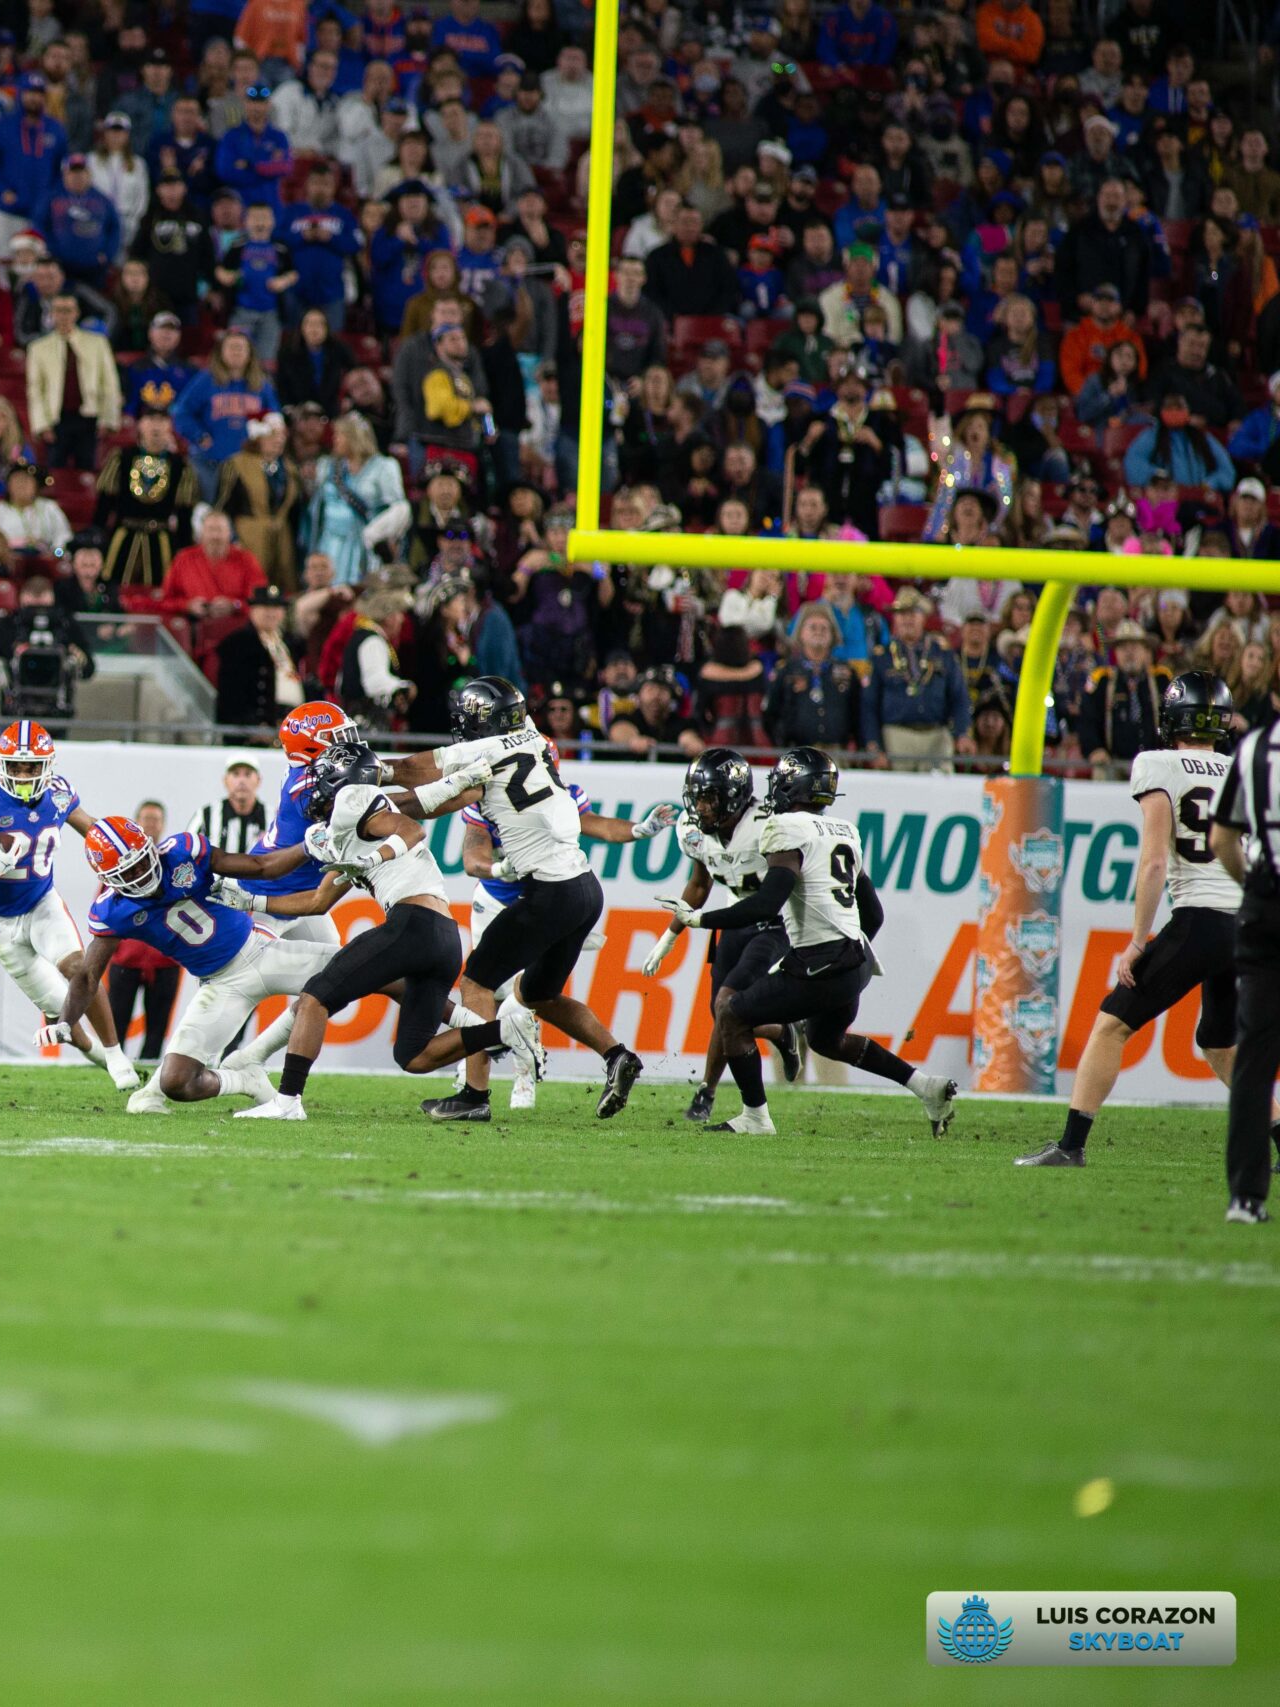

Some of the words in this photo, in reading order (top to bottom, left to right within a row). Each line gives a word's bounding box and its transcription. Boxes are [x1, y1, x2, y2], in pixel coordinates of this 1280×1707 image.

[0, 825, 62, 881] 20
[830, 843, 856, 909] 9
[164, 897, 217, 948] 0
